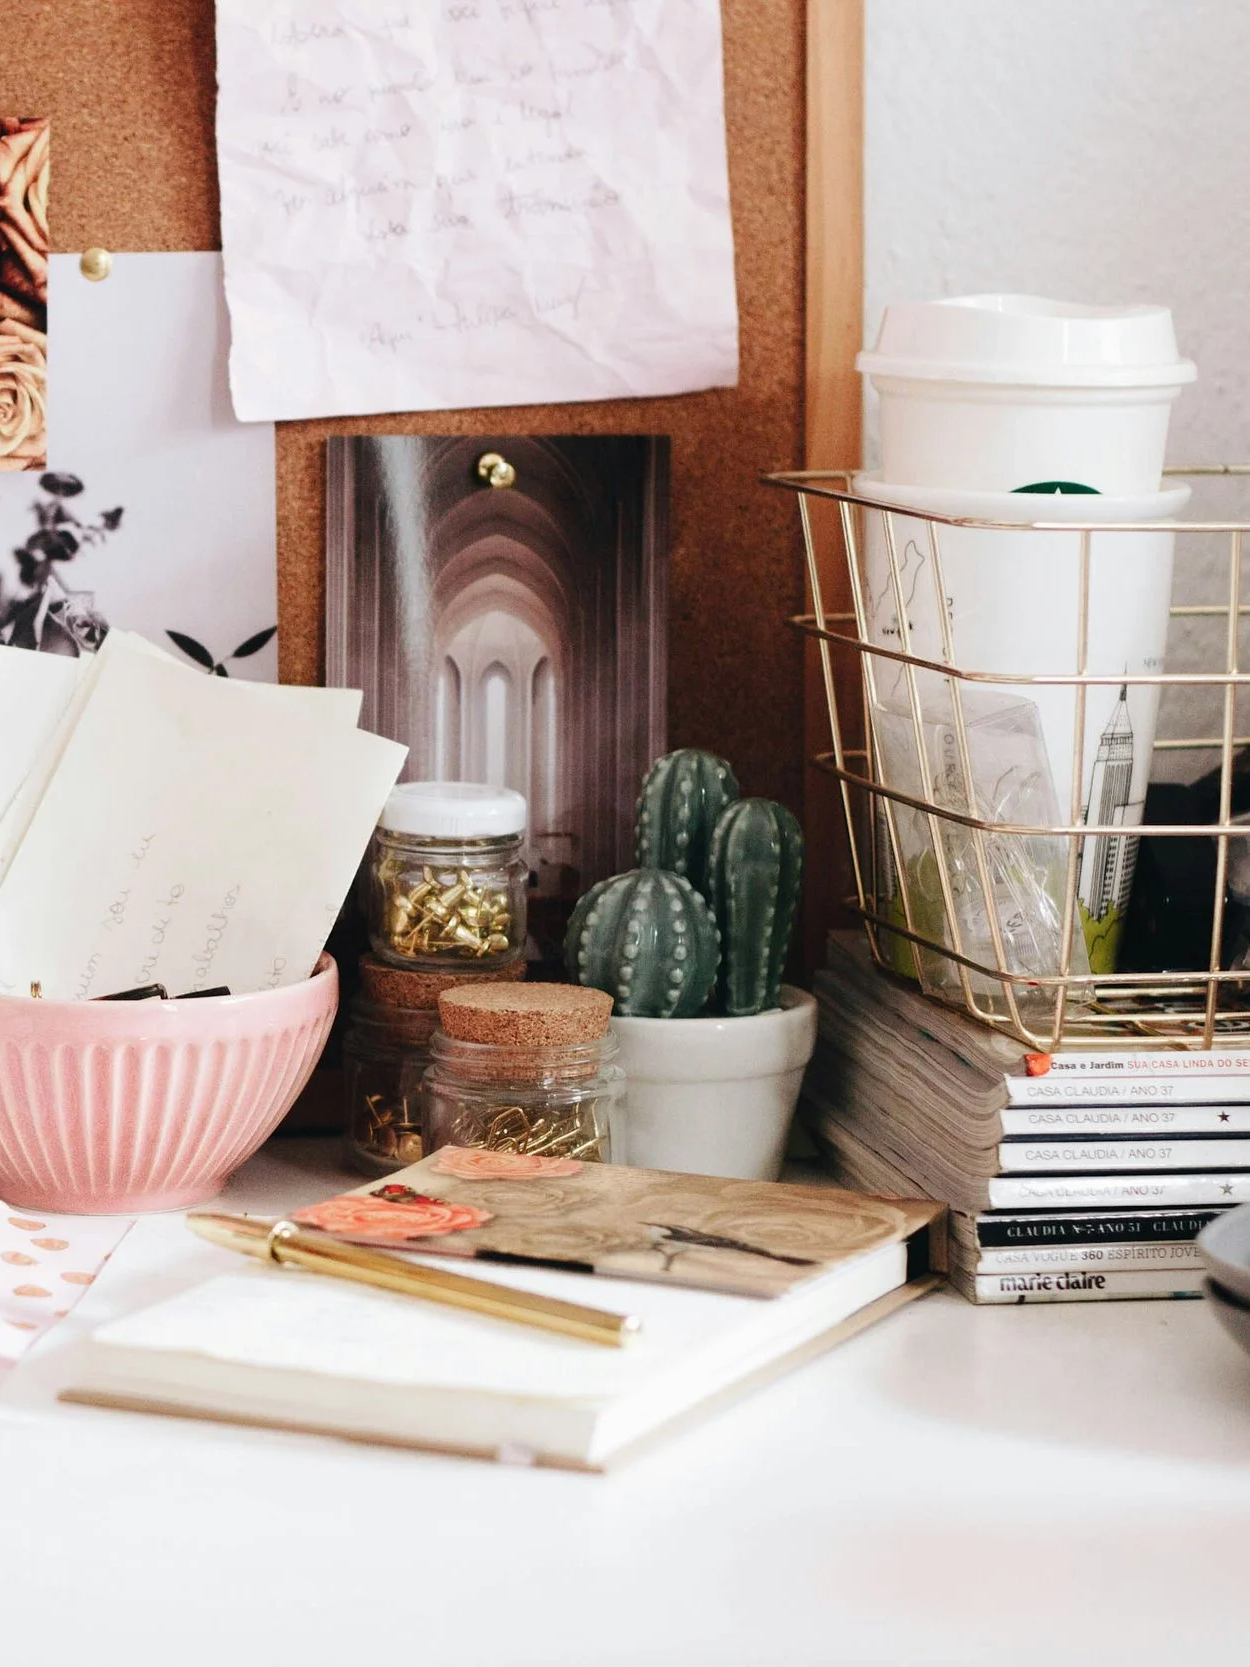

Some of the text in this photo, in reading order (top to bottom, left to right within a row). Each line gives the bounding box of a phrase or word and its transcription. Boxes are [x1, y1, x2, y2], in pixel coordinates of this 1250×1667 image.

[1051, 1061, 1077, 1071] Casa
[1079, 1062, 1087, 1071] e
[1089, 1060, 1125, 1071] Jardim
[1127, 1060, 1149, 1070] SUA
[1151, 1059, 1180, 1070] CASA
[1182, 1058, 1215, 1069] LINDA
[1217, 1058, 1233, 1069] DO
[1026, 1085, 1062, 1098] CASA
[1064, 1084, 1120, 1097] CLAUDIA
[1129, 1084, 1156, 1097] ANO
[1159, 1084, 1174, 1096] 37
[1027, 1113, 1063, 1125] CASA
[1065, 1112, 1120, 1125] CLAUDIA
[1131, 1111, 1159, 1124] ANO
[1161, 1111, 1175, 1123] 37
[1024, 1149, 1060, 1161] CASA
[1062, 1148, 1119, 1161] CLAUDIA
[1128, 1147, 1155, 1160] ANO
[1158, 1147, 1173, 1159] 37
[1121, 1185, 1149, 1196] ANO
[1006, 1224, 1066, 1238] CLAUDIA
[1127, 1222, 1141, 1233] 51
[996, 1253, 1030, 1264] CASA
[1033, 1251, 1079, 1263] VOGUE
[1081, 1250, 1104, 1261] 360
[1107, 1245, 1167, 1261] ESPÍRITO
[1000, 1271, 1106, 1292] marie claire
